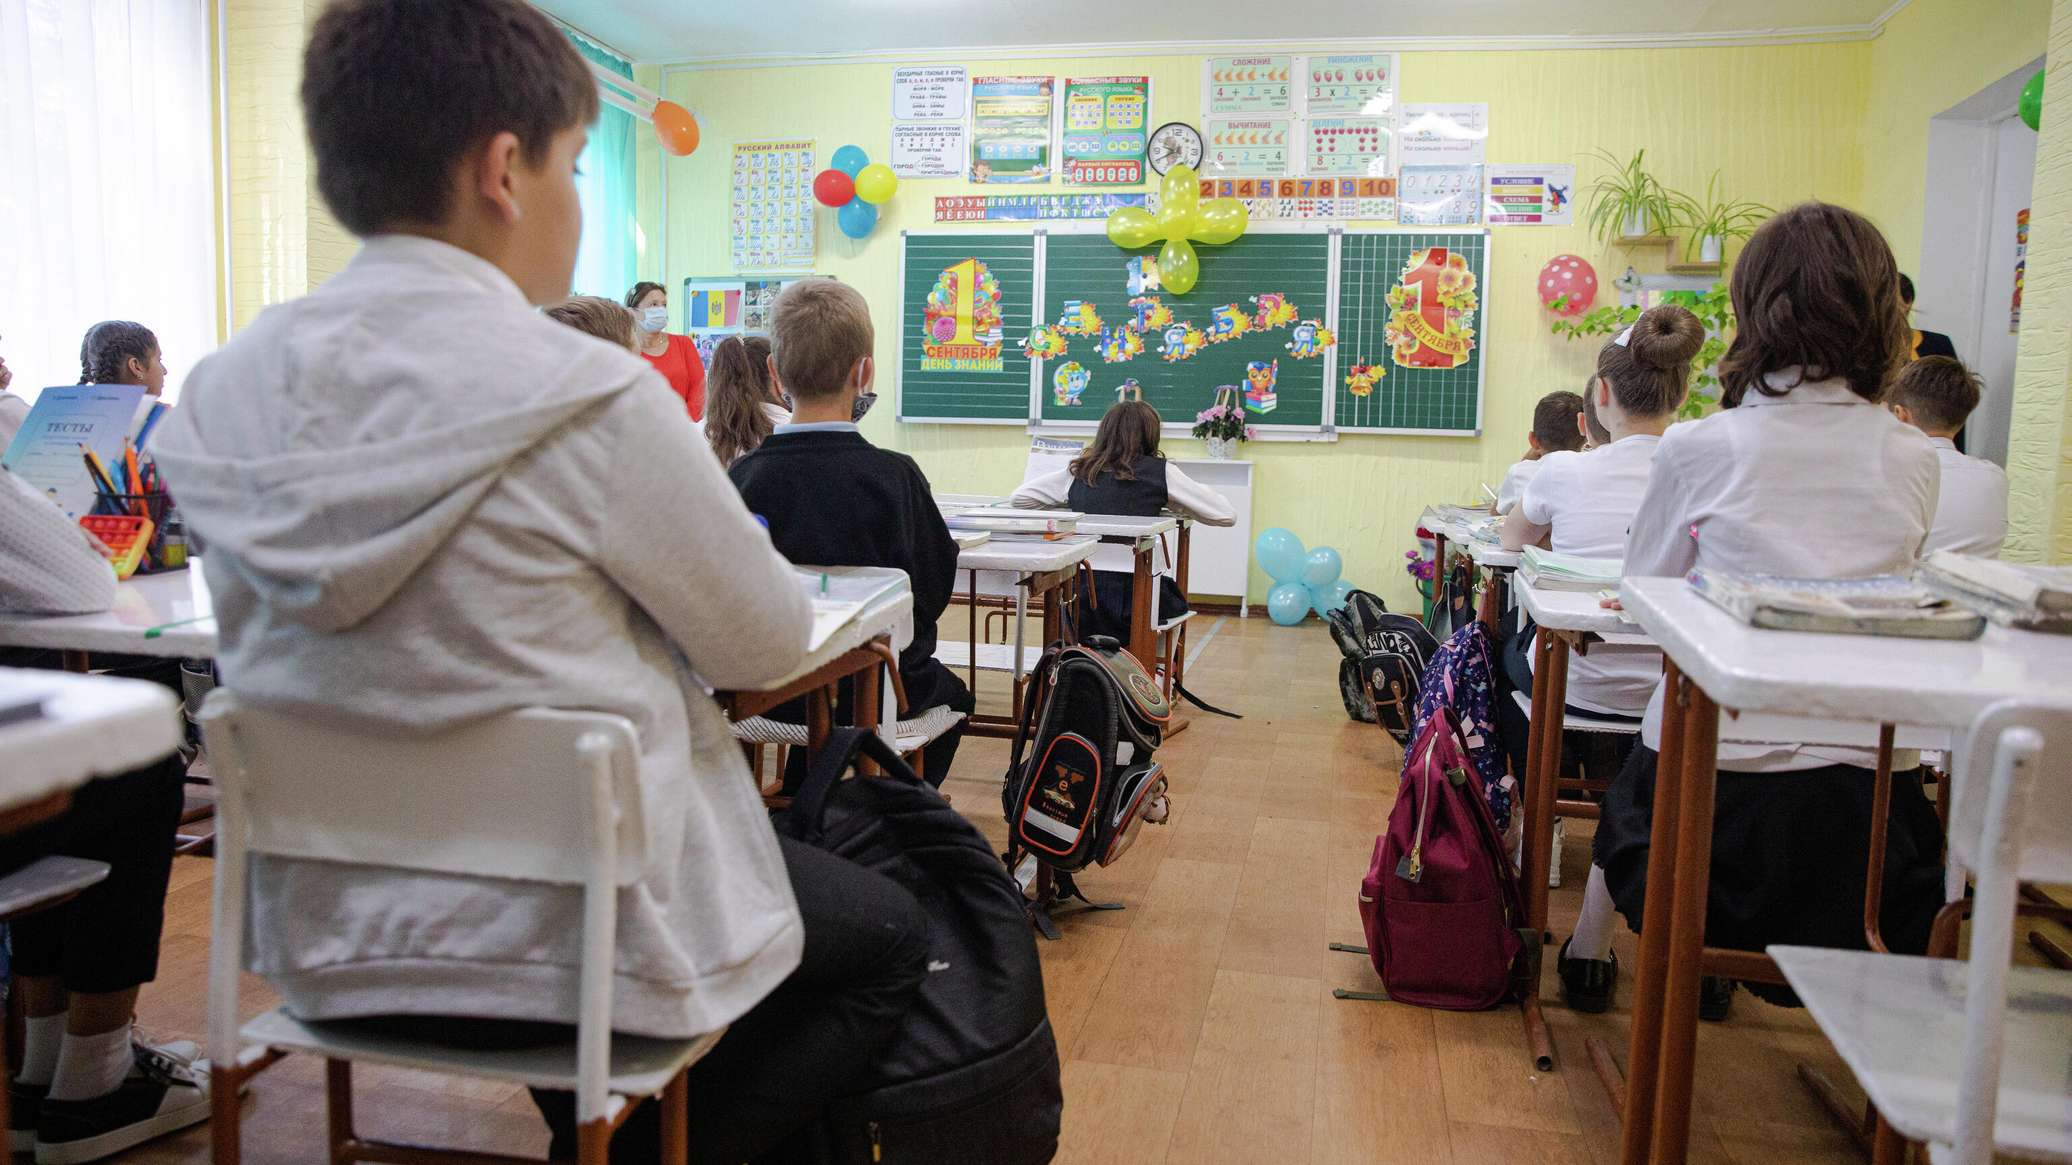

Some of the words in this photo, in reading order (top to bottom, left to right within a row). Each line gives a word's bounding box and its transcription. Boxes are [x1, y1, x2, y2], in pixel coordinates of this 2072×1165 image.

[1232, 58, 1271, 66] СЛОЖЕНИЕ
[1216, 87, 1224, 96] 4
[1246, 86, 1253, 96] 2
[1280, 86, 1287, 96] 6
[1315, 87, 1321, 97] 3
[1228, 121, 1271, 129] ВЫЧИТАНИЕ
[1172, 128, 1184, 136] 12
[1190, 148, 1198, 156] 3
[738, 144, 772, 152] РУССКИЙ
[1217, 151, 1224, 161] 6
[1244, 151, 1250, 160] 2
[1275, 151, 1281, 160] 4
[1317, 156, 1324, 166] 8
[1438, 175, 1447, 187] 2
[1200, 182, 1213, 196] 2
[1221, 182, 1232, 196] 3
[1240, 182, 1252, 196] 4
[1260, 182, 1270, 196] 5
[1280, 182, 1292, 196] 6
[1300, 182, 1312, 196] 7
[1319, 181, 1331, 196] 8
[1342, 181, 1354, 196] 9
[1364, 181, 1391, 196] 10
[1454, 200, 1461, 214] 8
[944, 257, 983, 346] 1
[1407, 313, 1462, 352] СЕНТЯБРЯ
[927, 346, 998, 359] СЕНТЯБРЯ
[922, 358, 952, 370] ДЕНЬ
[955, 358, 1003, 370] ЗНАНИЙ
[46, 422, 95, 433] ТЕСТЫ
